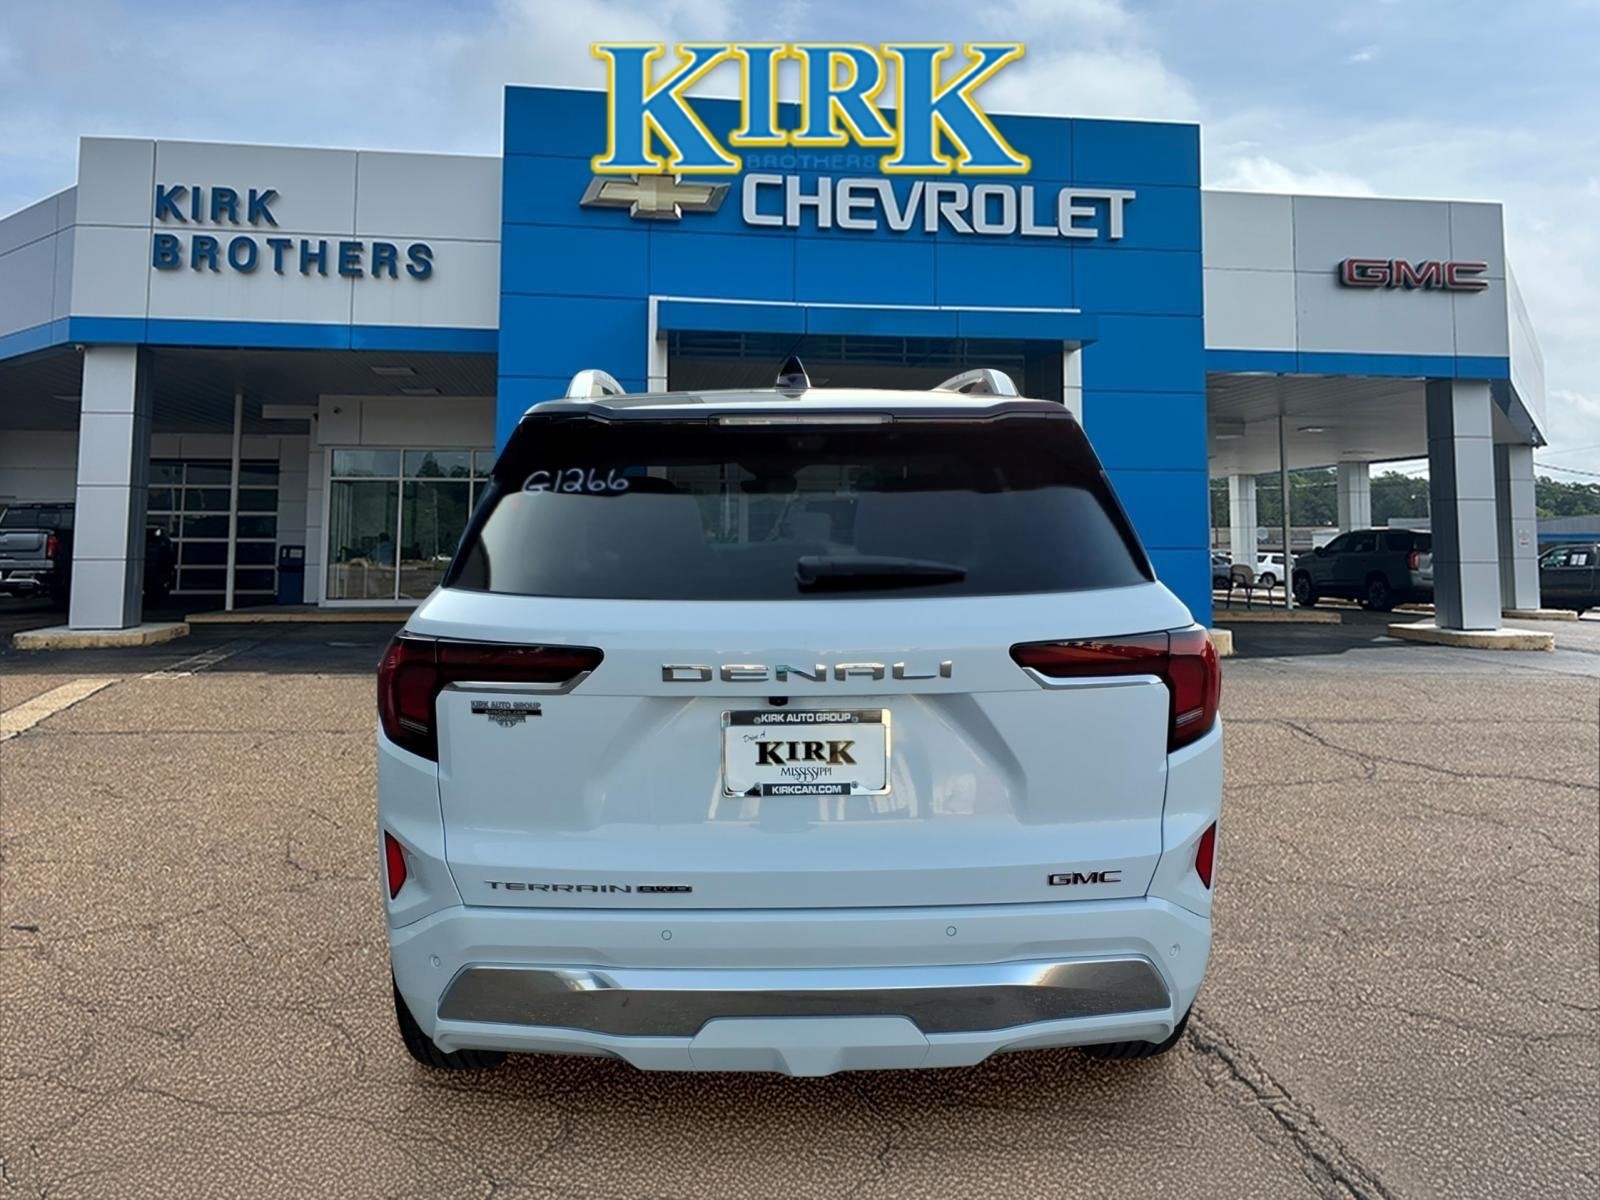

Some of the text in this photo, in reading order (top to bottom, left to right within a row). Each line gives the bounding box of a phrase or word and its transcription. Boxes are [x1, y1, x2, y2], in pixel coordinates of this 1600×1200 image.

[154, 184, 280, 227] KIRK
[742, 173, 1136, 239] CHEVROLET
[153, 233, 433, 280] BROTHERS
[1339, 257, 1488, 291] GMC
[521, 468, 629, 496] G1266
[661, 660, 953, 682] DENALI
[761, 712, 851, 722] KIRK AUTO GROUP
[755, 740, 857, 766] KIRK
[771, 785, 842, 794] KIRKCAN.COM
[484, 880, 632, 893] TERRAIN
[1047, 870, 1122, 886] GMC
